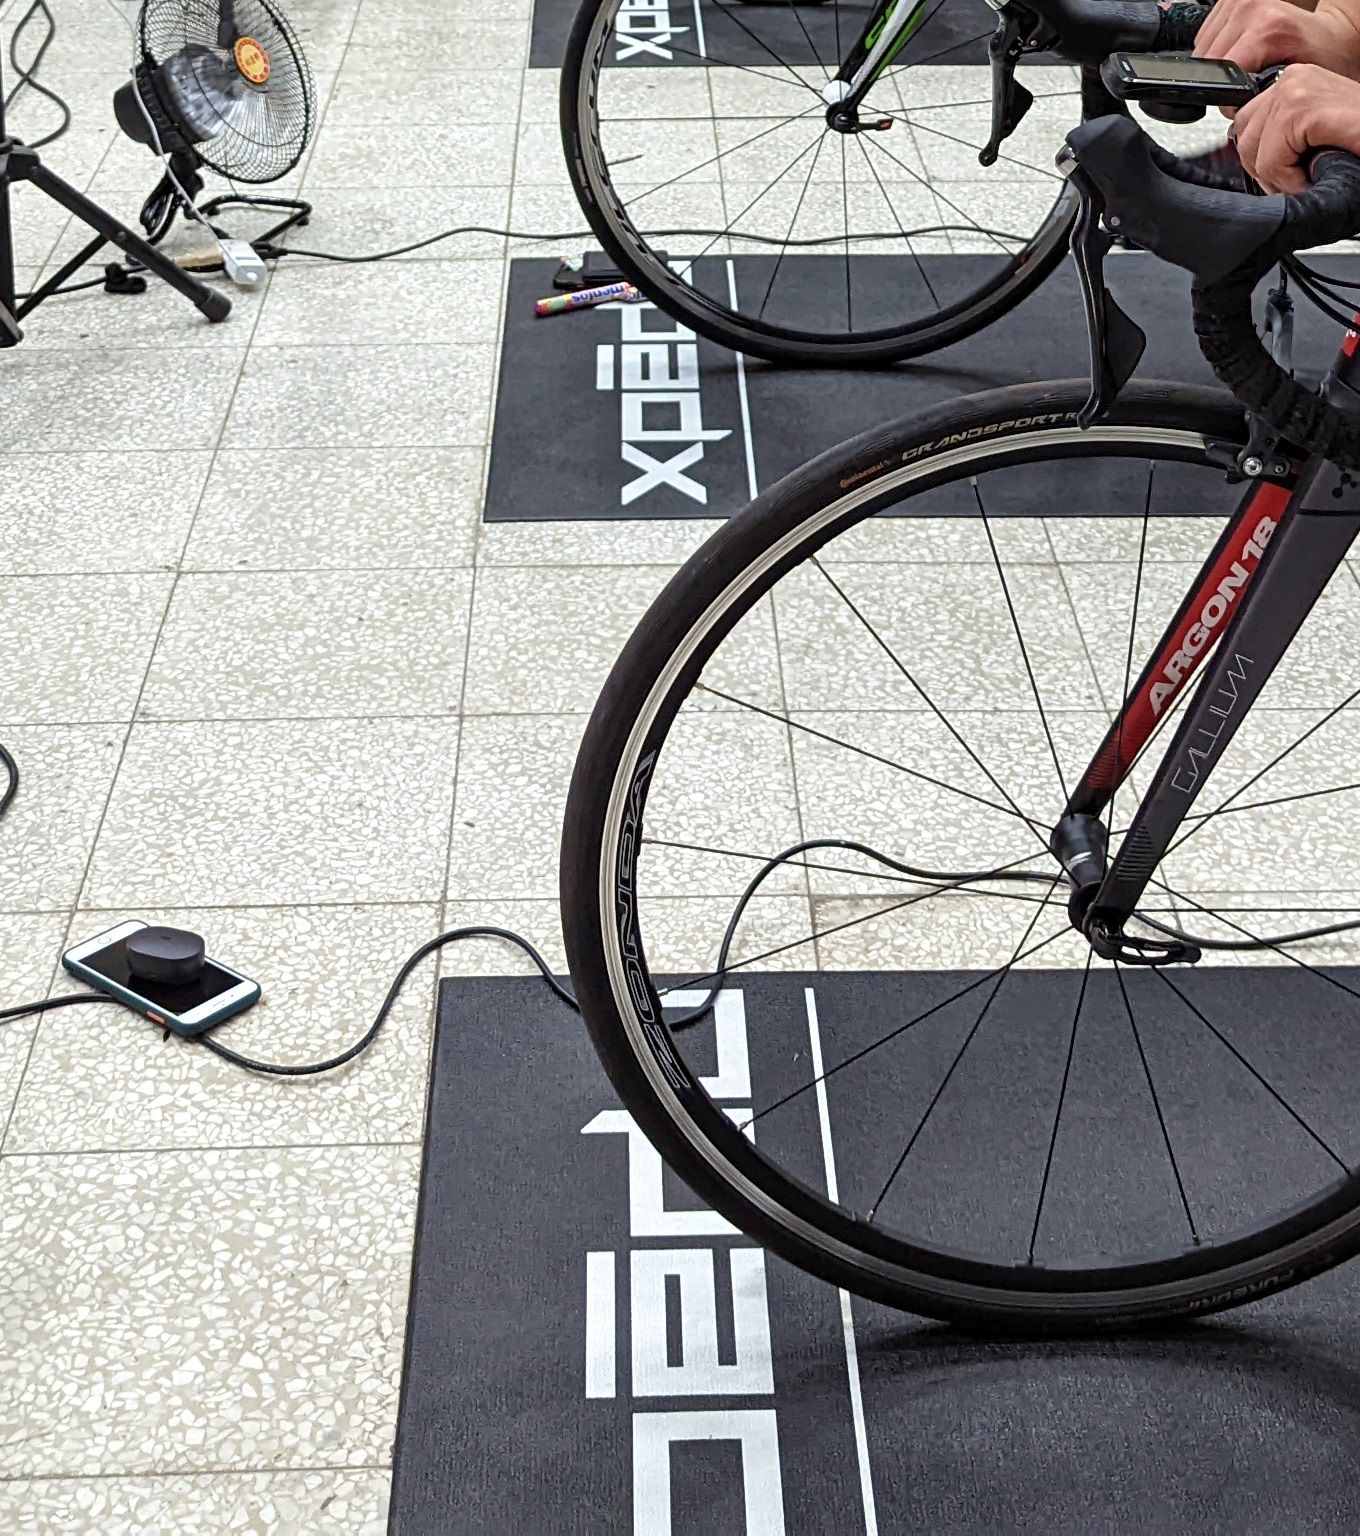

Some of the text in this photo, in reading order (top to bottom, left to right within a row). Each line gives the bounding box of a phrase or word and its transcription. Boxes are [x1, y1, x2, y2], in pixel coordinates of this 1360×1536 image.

[1148, 515, 1278, 717] ARGON 18
[618, 748, 691, 1089] ZONDA
